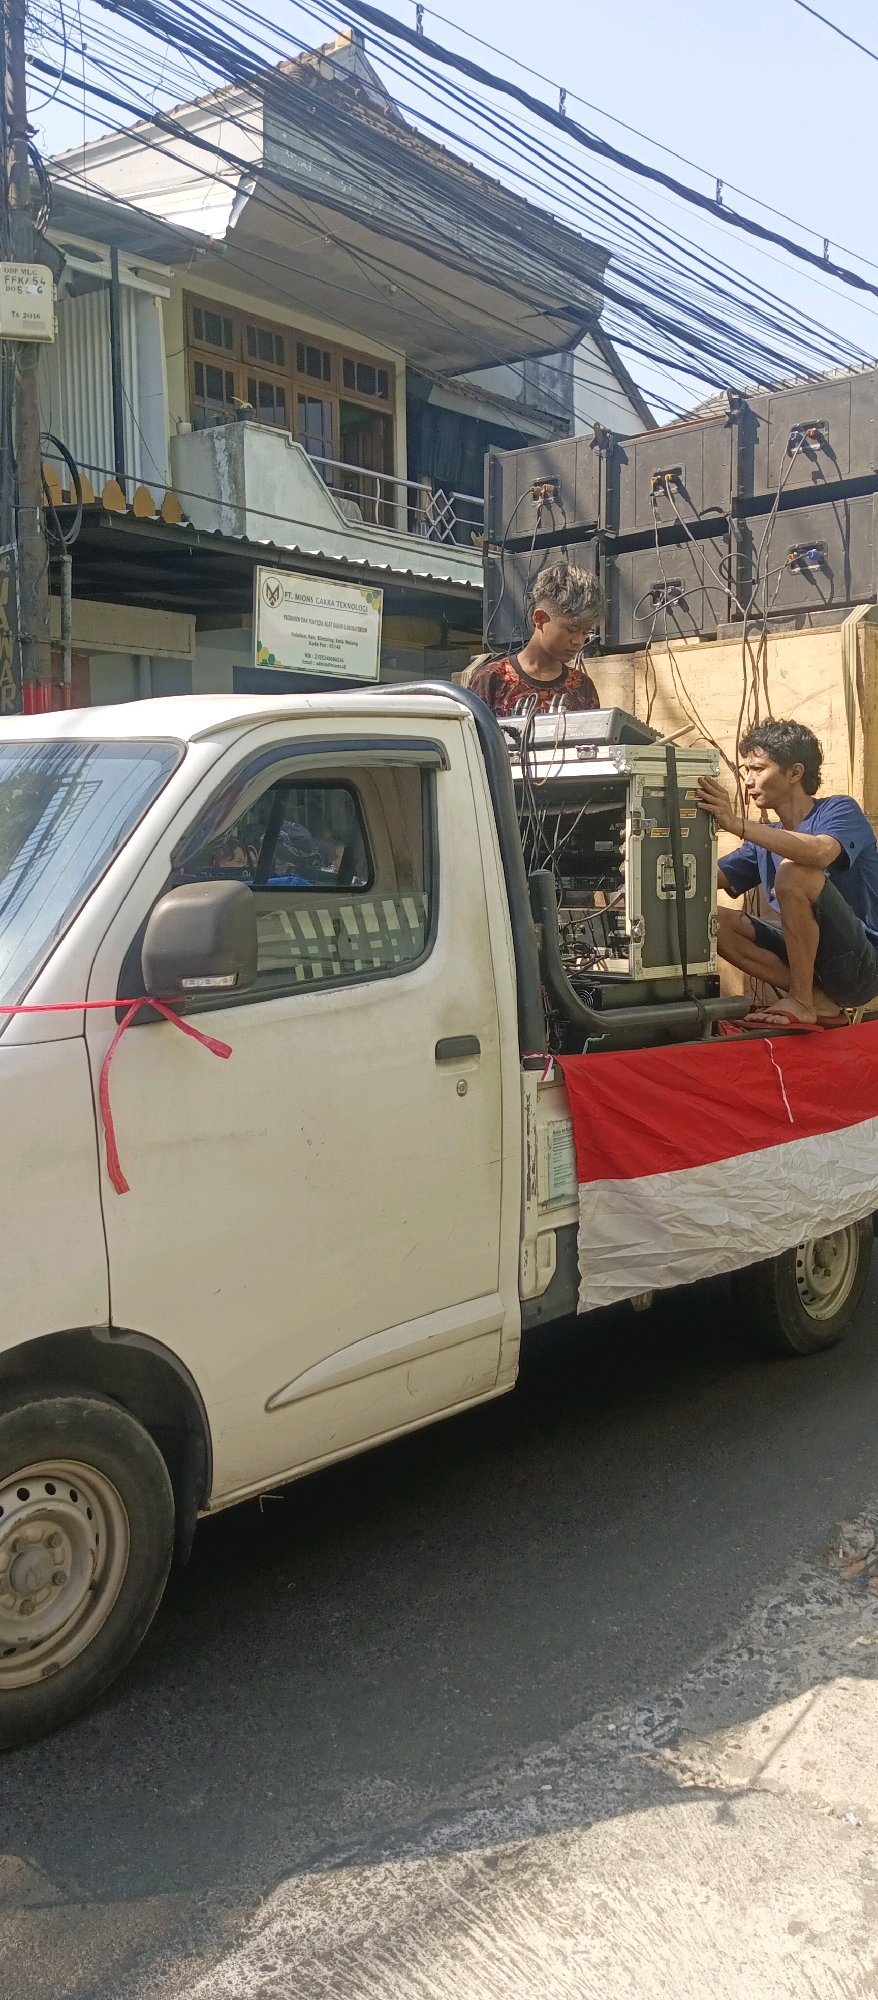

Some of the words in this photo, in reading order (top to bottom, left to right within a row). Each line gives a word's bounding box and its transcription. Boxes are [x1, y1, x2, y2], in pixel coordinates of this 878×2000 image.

[22, 312, 41, 320] 2016
[284, 591, 294, 600] PT.
[295, 593, 314, 603] MIONS
[315, 597, 335, 607] CAKRA
[336, 601, 369, 612] TEKNOLOGI
